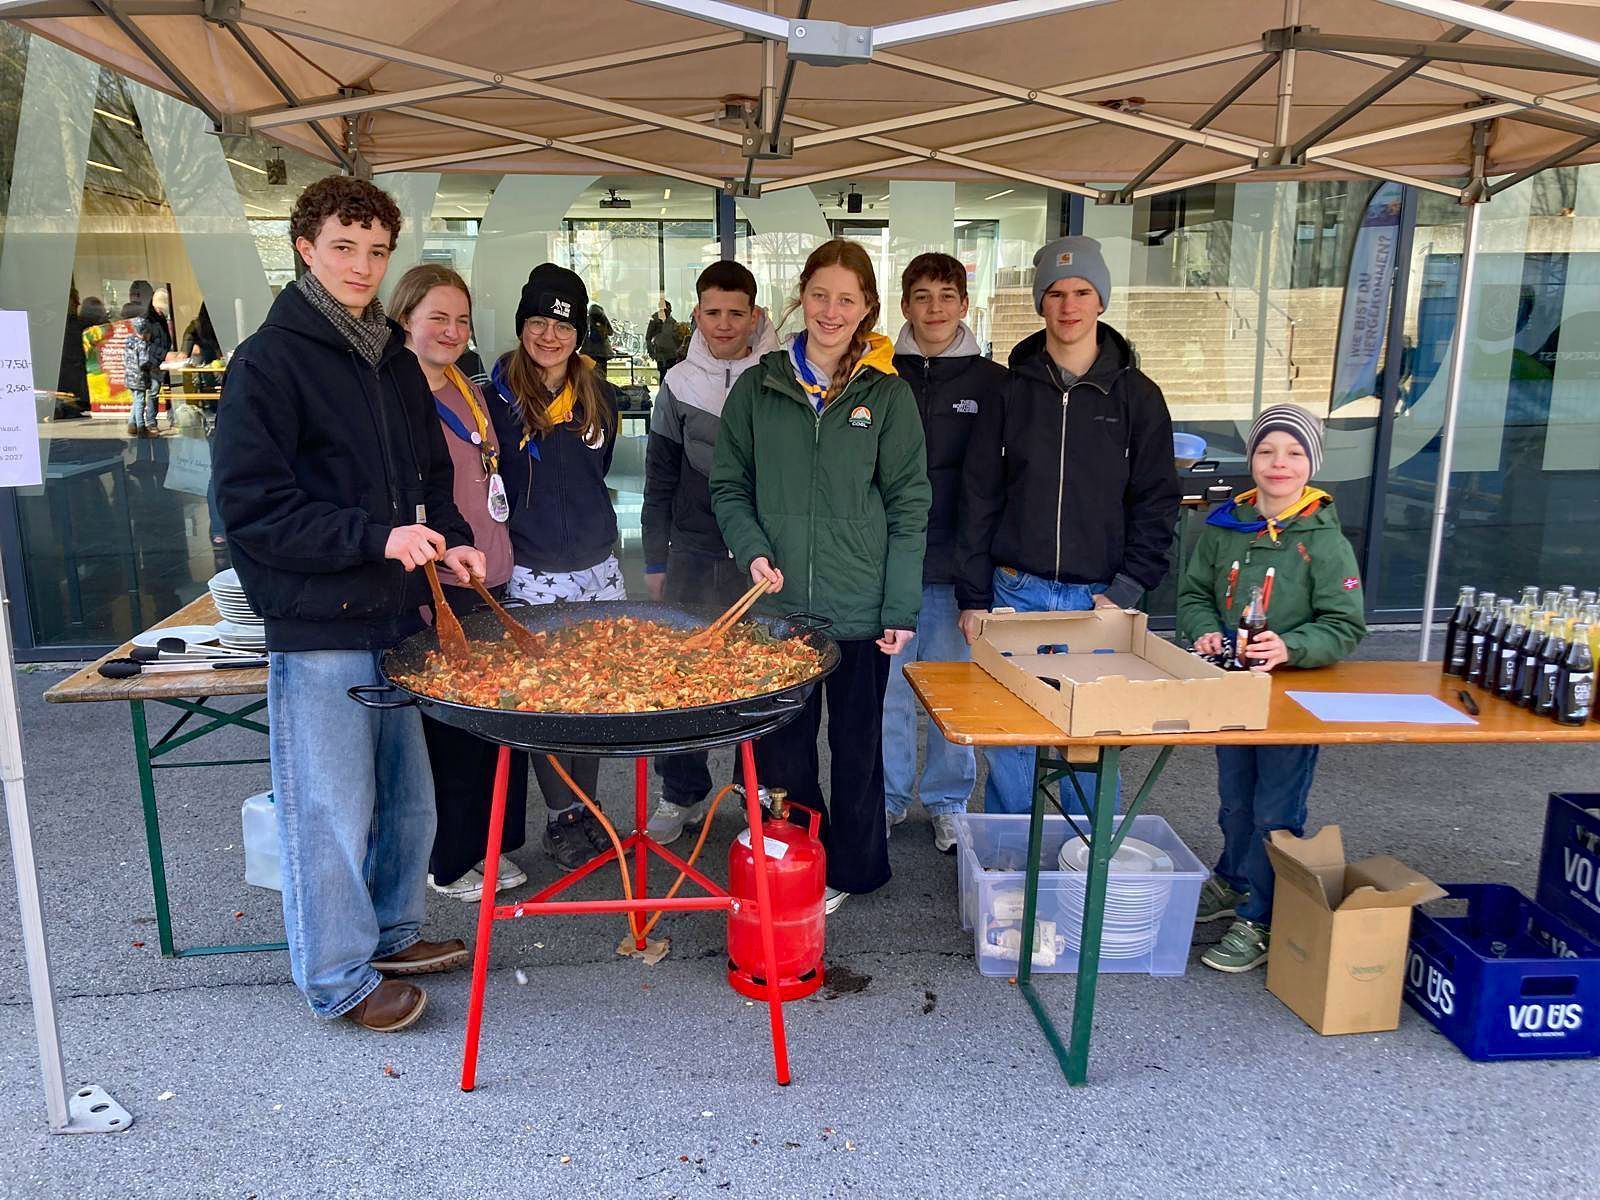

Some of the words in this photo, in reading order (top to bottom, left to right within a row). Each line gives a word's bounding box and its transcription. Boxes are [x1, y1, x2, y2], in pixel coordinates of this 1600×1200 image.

[1359, 272, 1371, 297] DU
[1364, 235, 1392, 358] HERGEKOMMEN?
[1354, 299, 1368, 332] BIST
[1350, 333, 1363, 358] WIE
[1508, 1004, 1544, 1031] VO
